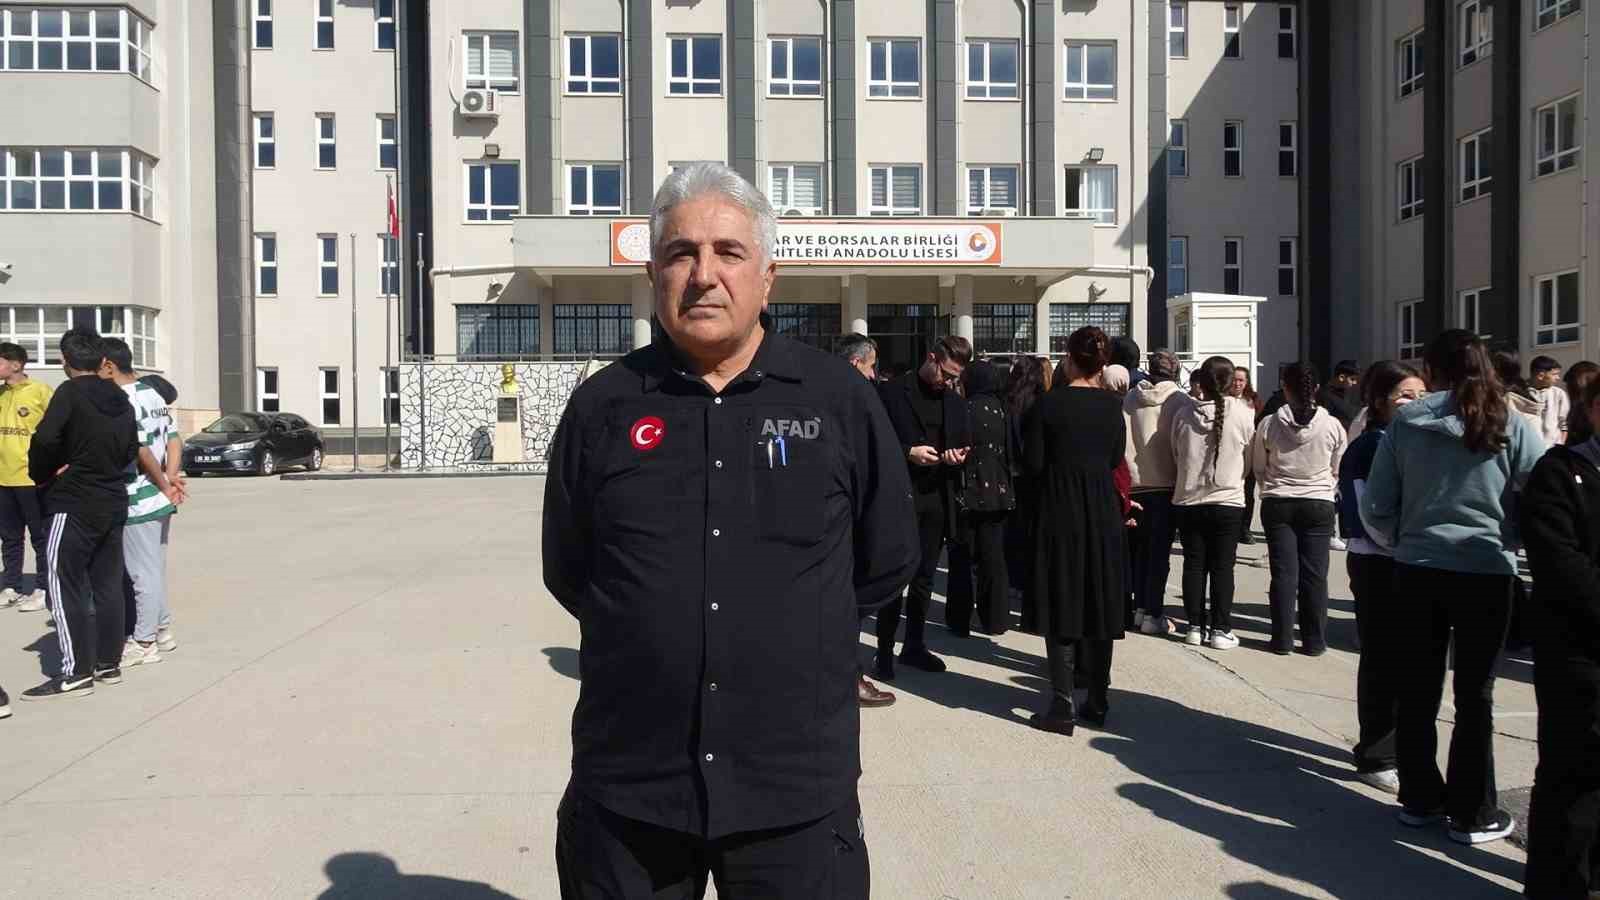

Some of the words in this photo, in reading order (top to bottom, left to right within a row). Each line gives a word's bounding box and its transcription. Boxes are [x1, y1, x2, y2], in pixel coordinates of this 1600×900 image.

[795, 235, 814, 245] VE
[818, 235, 899, 245] BORSALAR
[904, 233, 958, 245] BİRLİĞİ
[833, 248, 908, 258] ANADOLU
[913, 246, 958, 258] LİSESİ
[761, 418, 820, 439] AFAD
